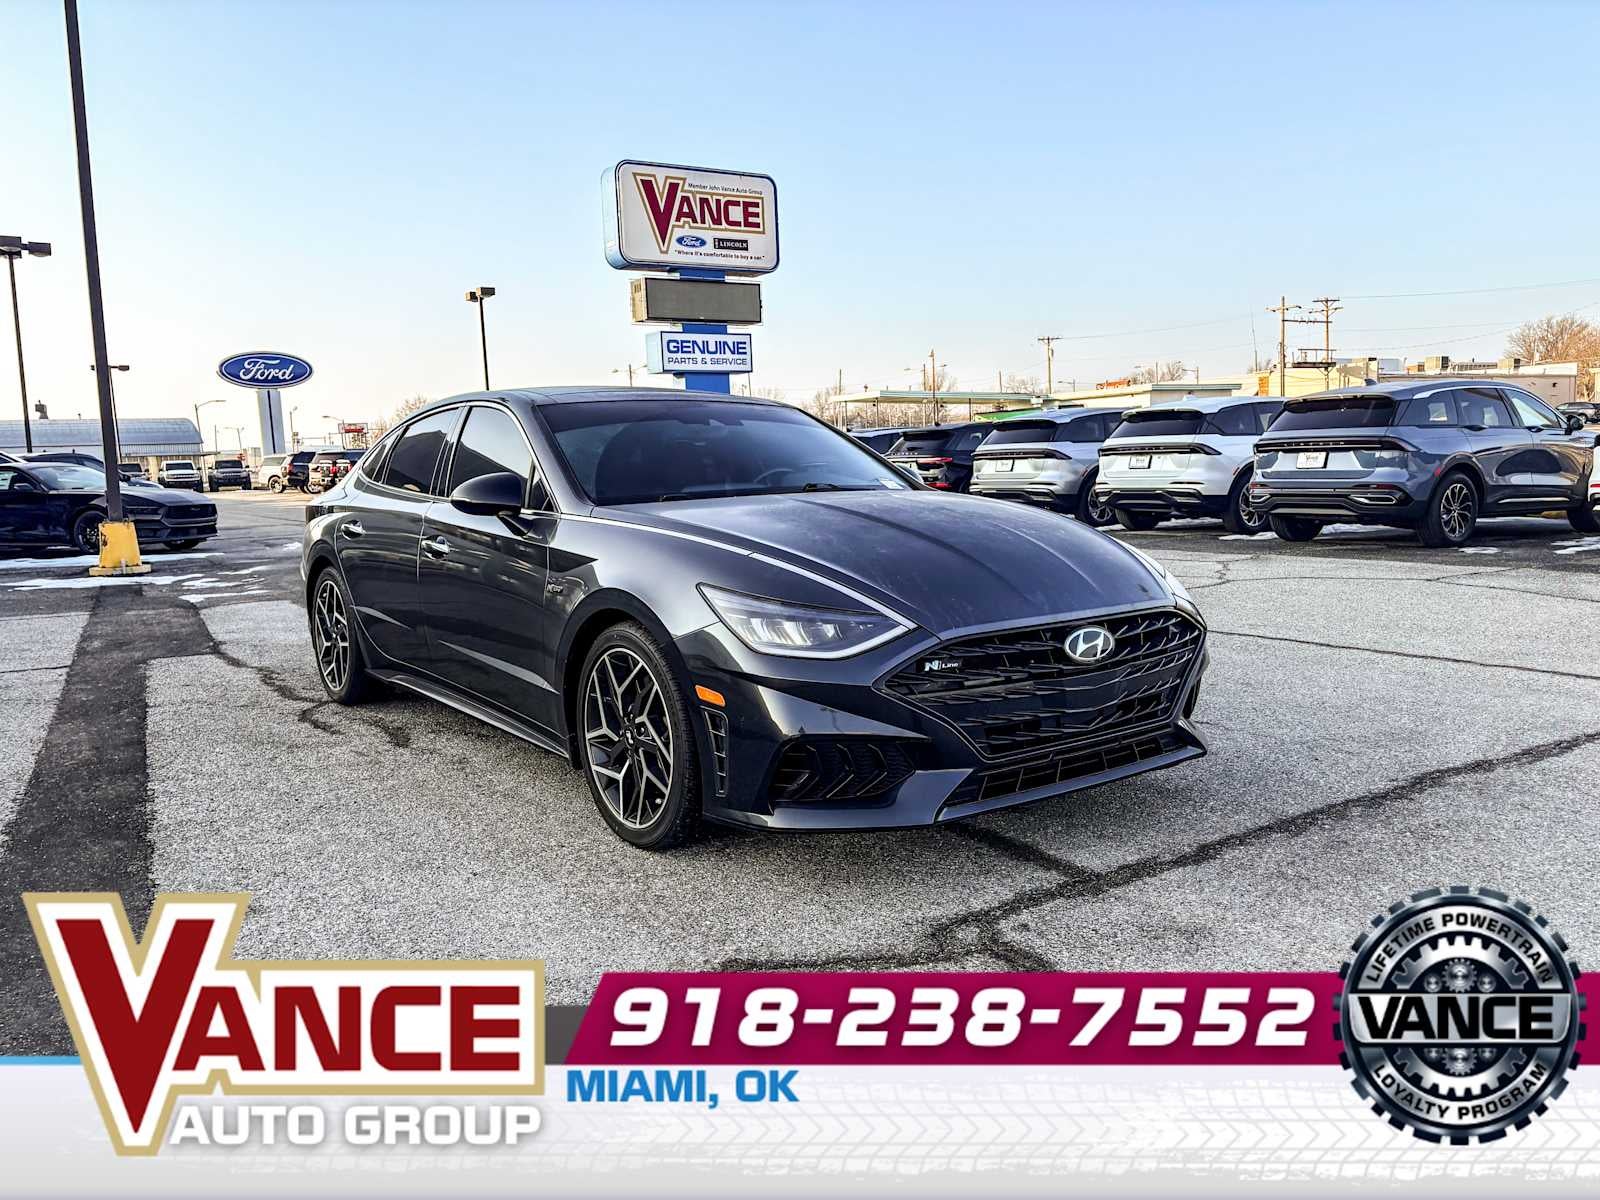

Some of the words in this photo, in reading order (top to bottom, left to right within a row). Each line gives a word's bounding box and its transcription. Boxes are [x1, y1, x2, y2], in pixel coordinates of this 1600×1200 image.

[639, 178, 761, 247] VANCE
[681, 236, 701, 246] Ford
[666, 339, 748, 355] GENUINE
[240, 358, 294, 380] Ford
[667, 357, 698, 365] PARTS
[700, 357, 707, 365] &
[710, 357, 748, 366] SERVICE
